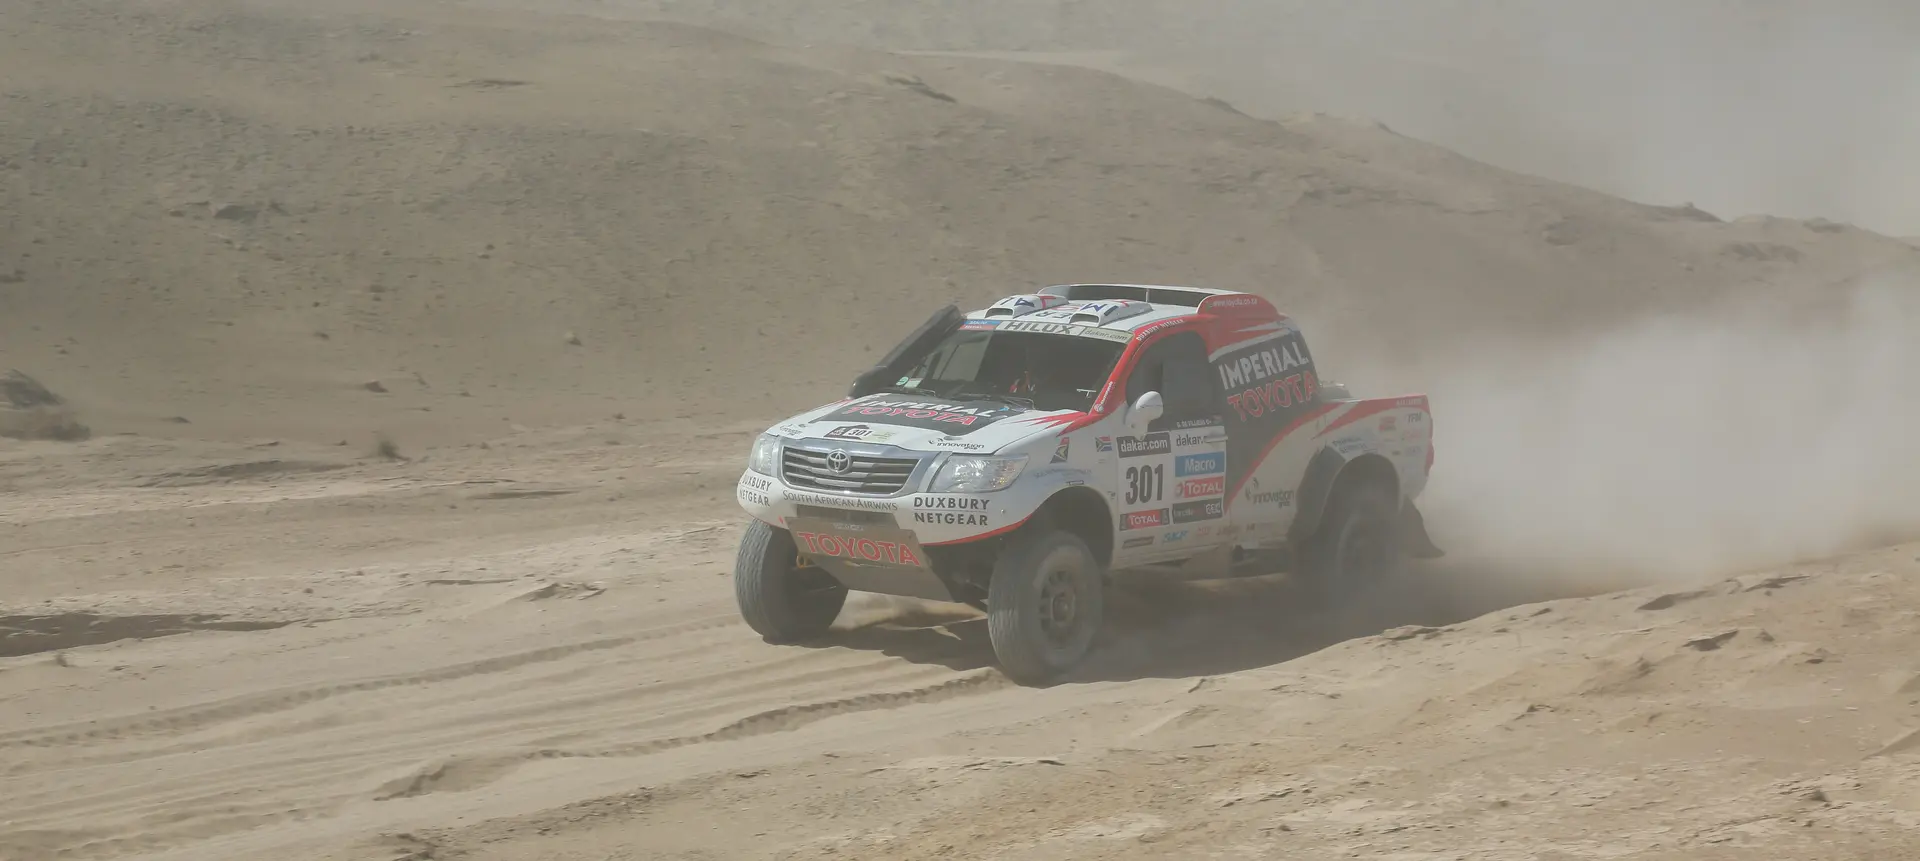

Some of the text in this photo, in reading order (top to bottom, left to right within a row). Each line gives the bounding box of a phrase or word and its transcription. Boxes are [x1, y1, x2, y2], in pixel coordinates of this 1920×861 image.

[1004, 320, 1075, 335] HILUX
[1084, 329, 1128, 341] dakar.com
[1218, 342, 1310, 390] IMPERIAL
[1227, 370, 1319, 422] TOYOTA
[843, 406, 979, 426] TOYOTA
[860, 400, 997, 418] IMPERIAL
[848, 429, 873, 437] 301
[936, 442, 985, 450] innovation
[1120, 438, 1168, 453] dakar.com
[1185, 457, 1216, 473] Macro
[1125, 463, 1164, 506] 301
[1185, 481, 1223, 495] TOTAL
[782, 489, 899, 511] SOUTH AFRICAN AIRWAYS
[914, 496, 991, 510] DUXBURY
[914, 512, 988, 526] NETGEAR
[1129, 514, 1160, 525] TOTAL
[797, 531, 921, 567] TOYOTA
